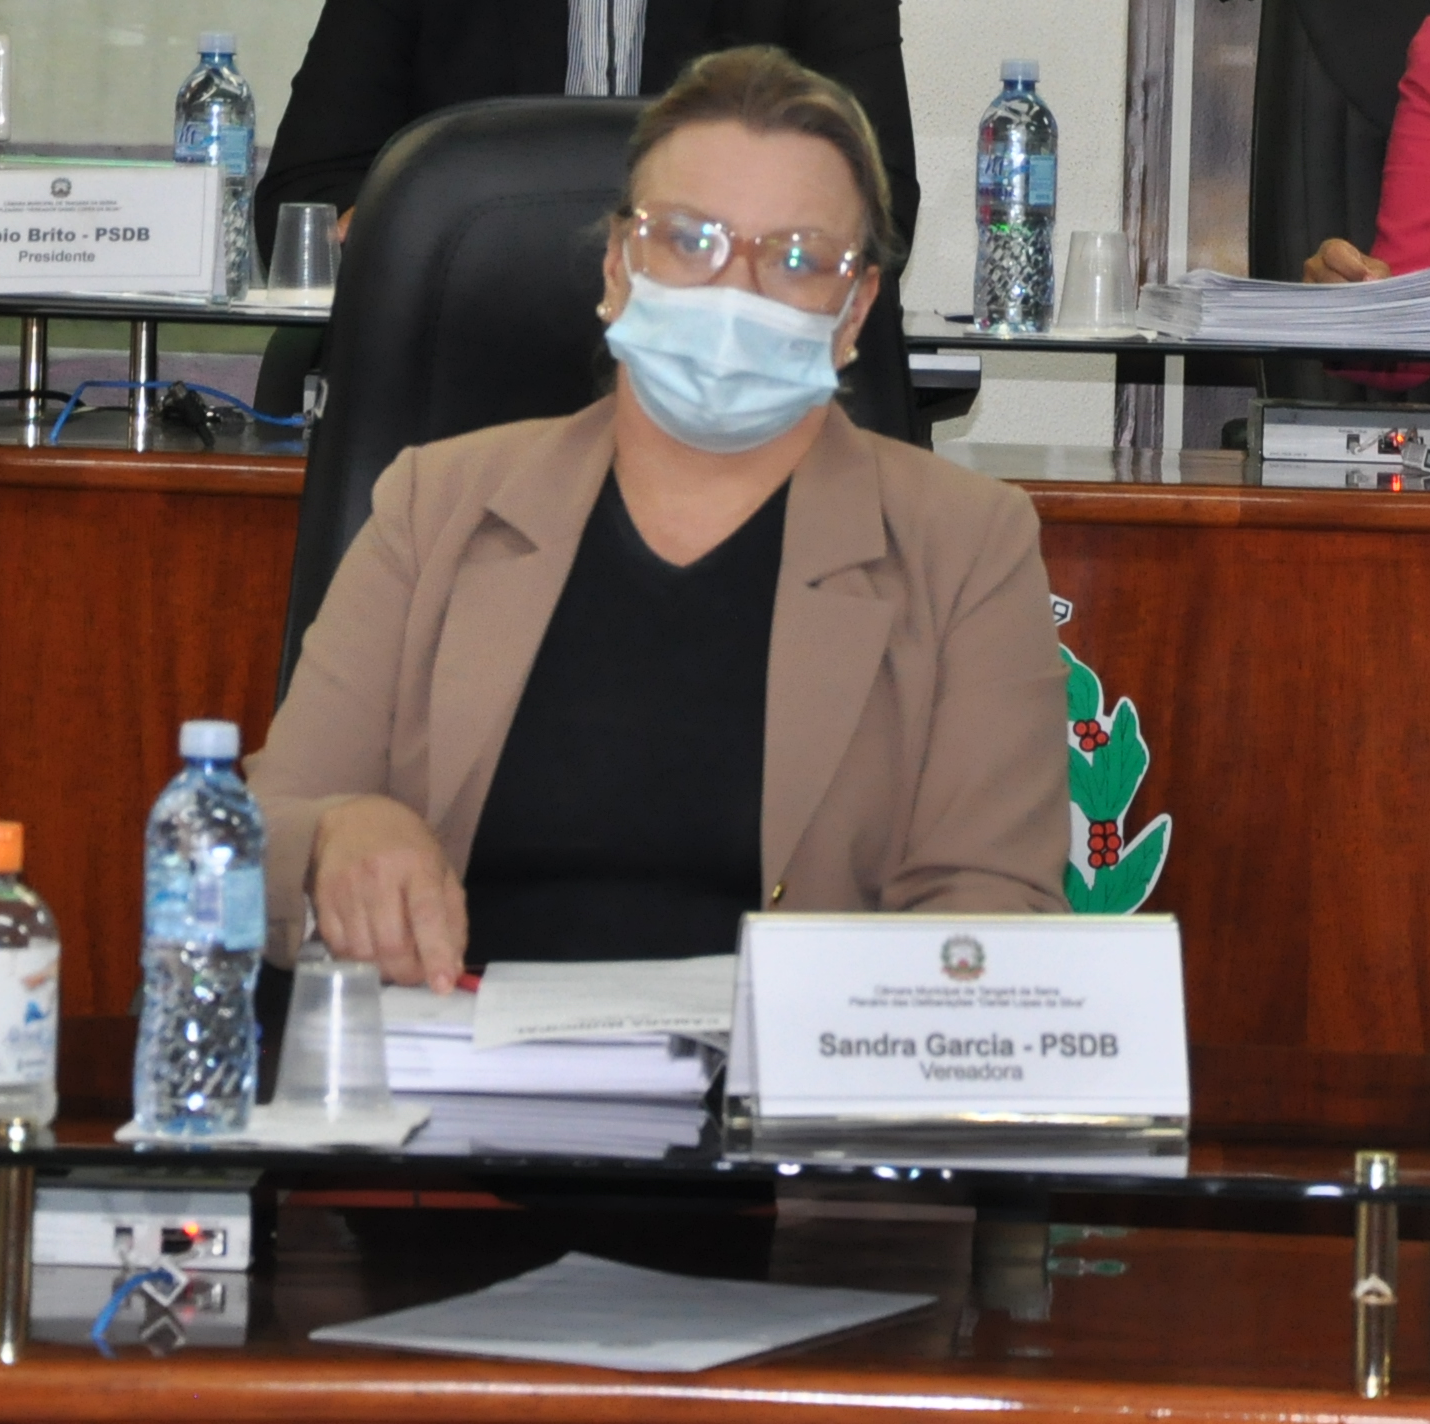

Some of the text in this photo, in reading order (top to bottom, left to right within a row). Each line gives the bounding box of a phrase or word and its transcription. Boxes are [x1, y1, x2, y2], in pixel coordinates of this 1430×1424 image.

[27, 227, 76, 244] Brito
[94, 227, 150, 244] PSDB
[18, 249, 96, 264] Presidente
[819, 1033, 916, 1058] Sandra
[925, 1033, 1014, 1058] Garcia
[1040, 1034, 1119, 1058] PSDB
[920, 1062, 1024, 1081] Vereadora
